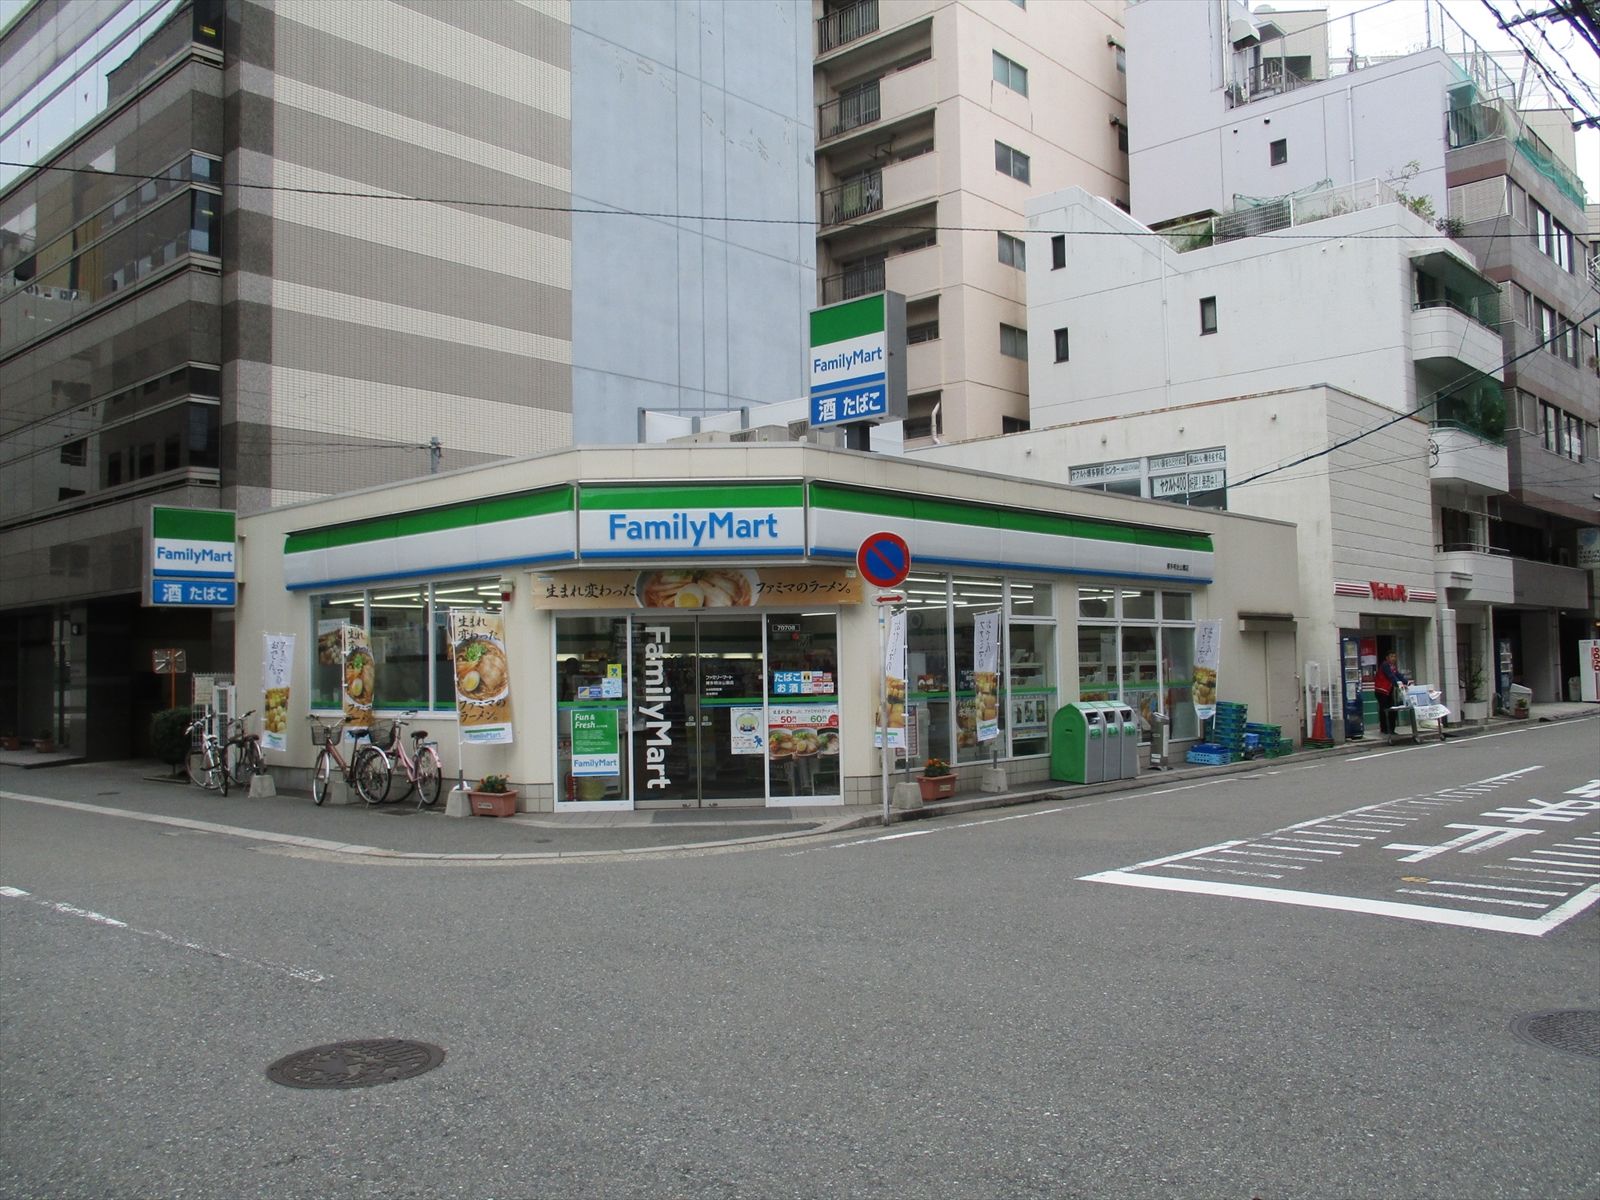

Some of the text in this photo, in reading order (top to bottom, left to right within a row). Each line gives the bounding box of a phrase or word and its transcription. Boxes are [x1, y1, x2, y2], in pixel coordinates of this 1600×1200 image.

[814, 347, 882, 373] FamilyMart
[819, 392, 881, 422] 酒 たばこ
[609, 512, 778, 547] FamilyMart
[157, 546, 232, 564] FamilyMart
[163, 583, 228, 602] 酒 たばこ
[756, 580, 851, 594] ファミマのラーメン。
[458, 615, 487, 627] 生まれ
[774, 673, 801, 682] たばこ
[777, 683, 798, 693] お酒
[638, 626, 672, 789] FamilyMart
[575, 713, 589, 721] Fun
[575, 721, 596, 729] Fresh
[574, 759, 617, 767] FamilyMart
